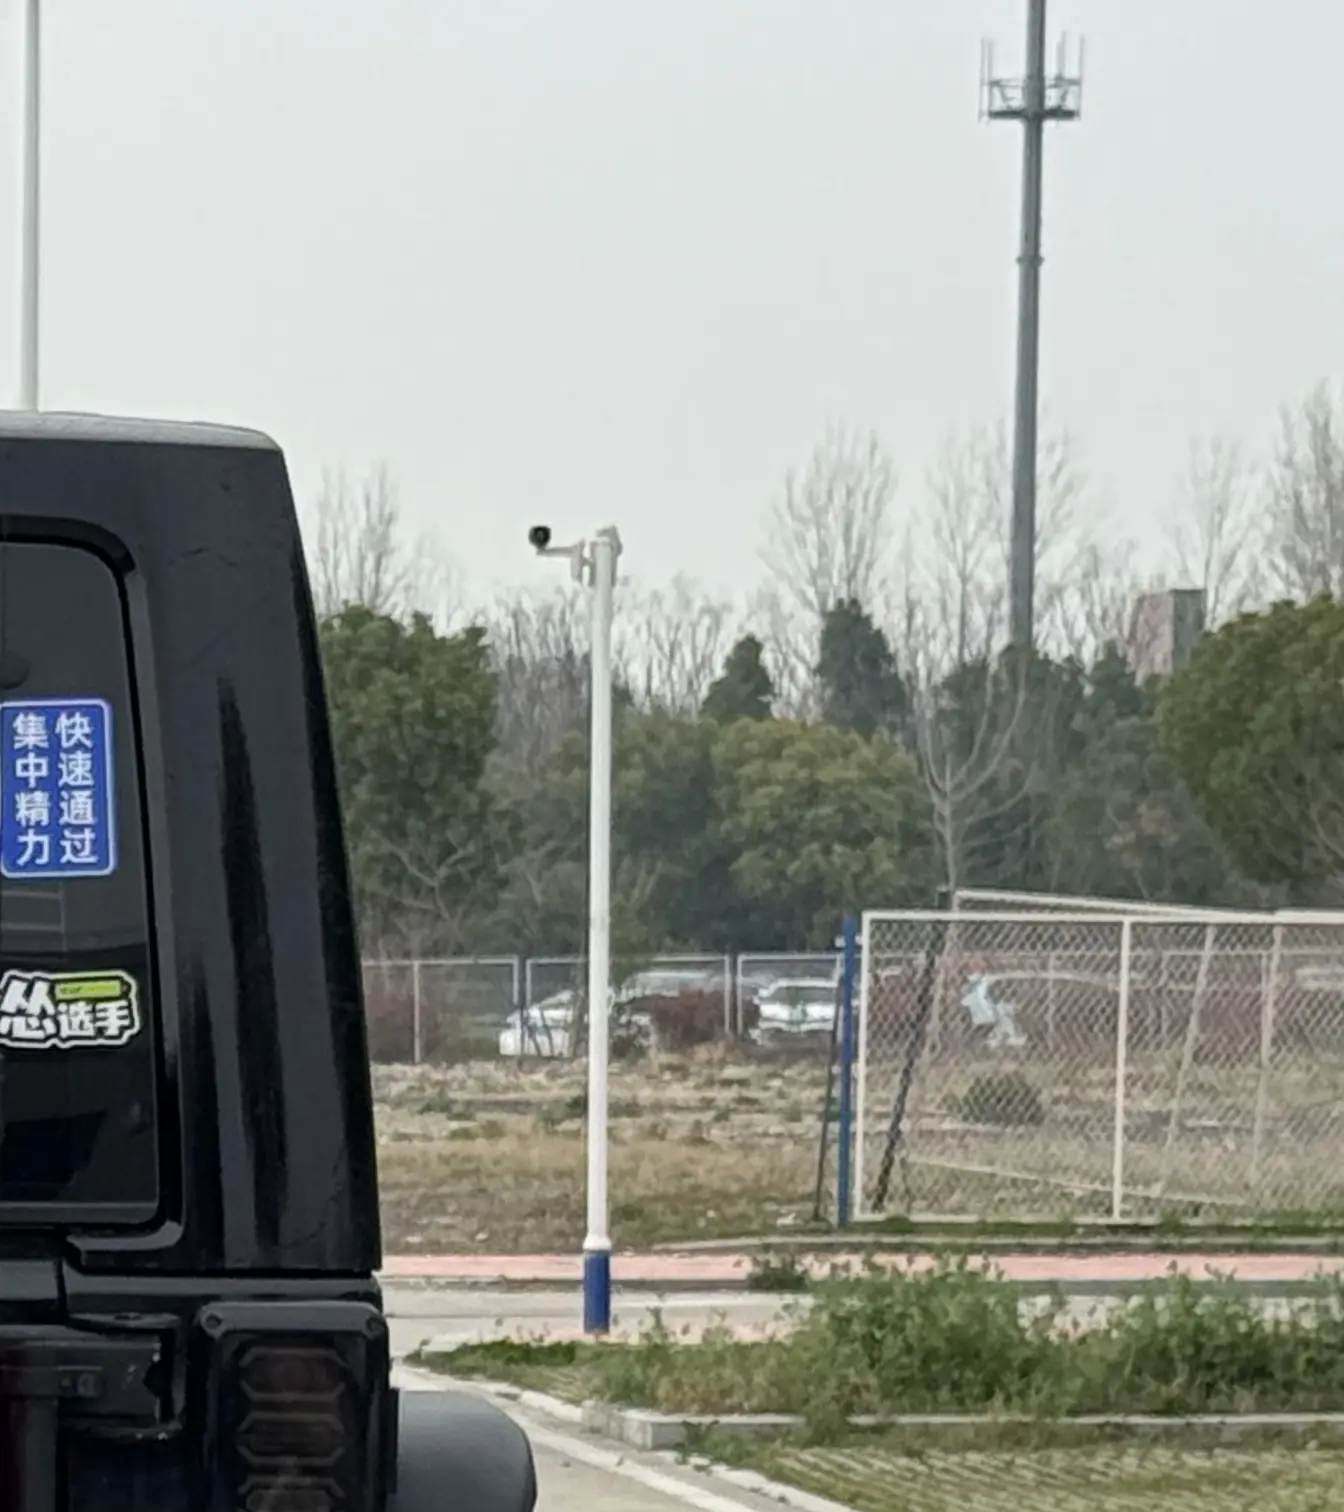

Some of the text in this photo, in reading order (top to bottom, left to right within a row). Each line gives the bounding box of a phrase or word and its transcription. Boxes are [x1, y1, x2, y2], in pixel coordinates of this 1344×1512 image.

[12, 711, 50, 866] 集中精力
[55, 711, 98, 864] 快速通过
